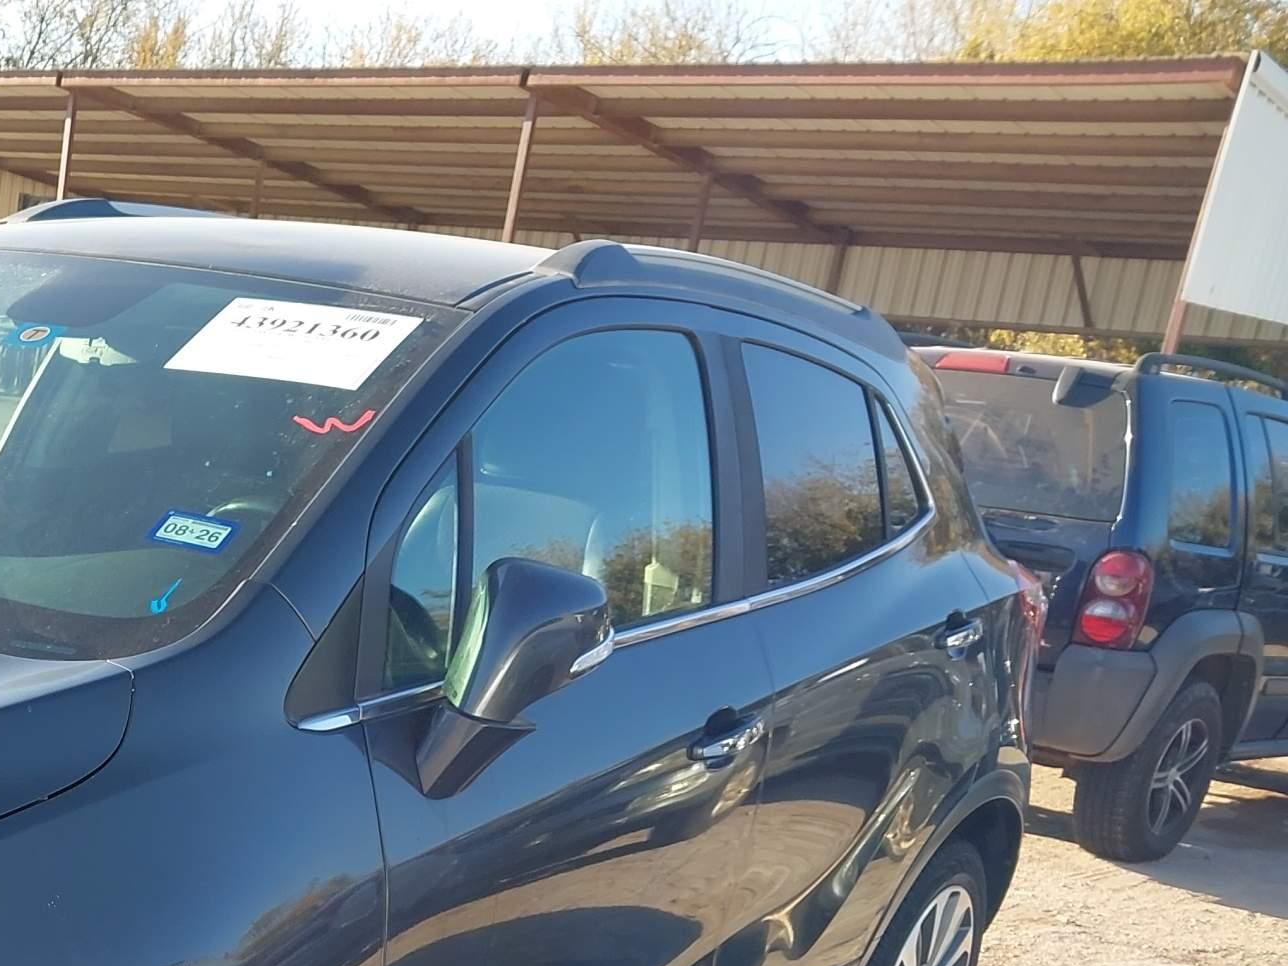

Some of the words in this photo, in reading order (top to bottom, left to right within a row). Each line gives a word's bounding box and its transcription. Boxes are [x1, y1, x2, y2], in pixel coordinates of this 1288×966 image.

[231, 314, 381, 343] 43921360
[163, 522, 190, 537] 08
[194, 529, 222, 543] 26
